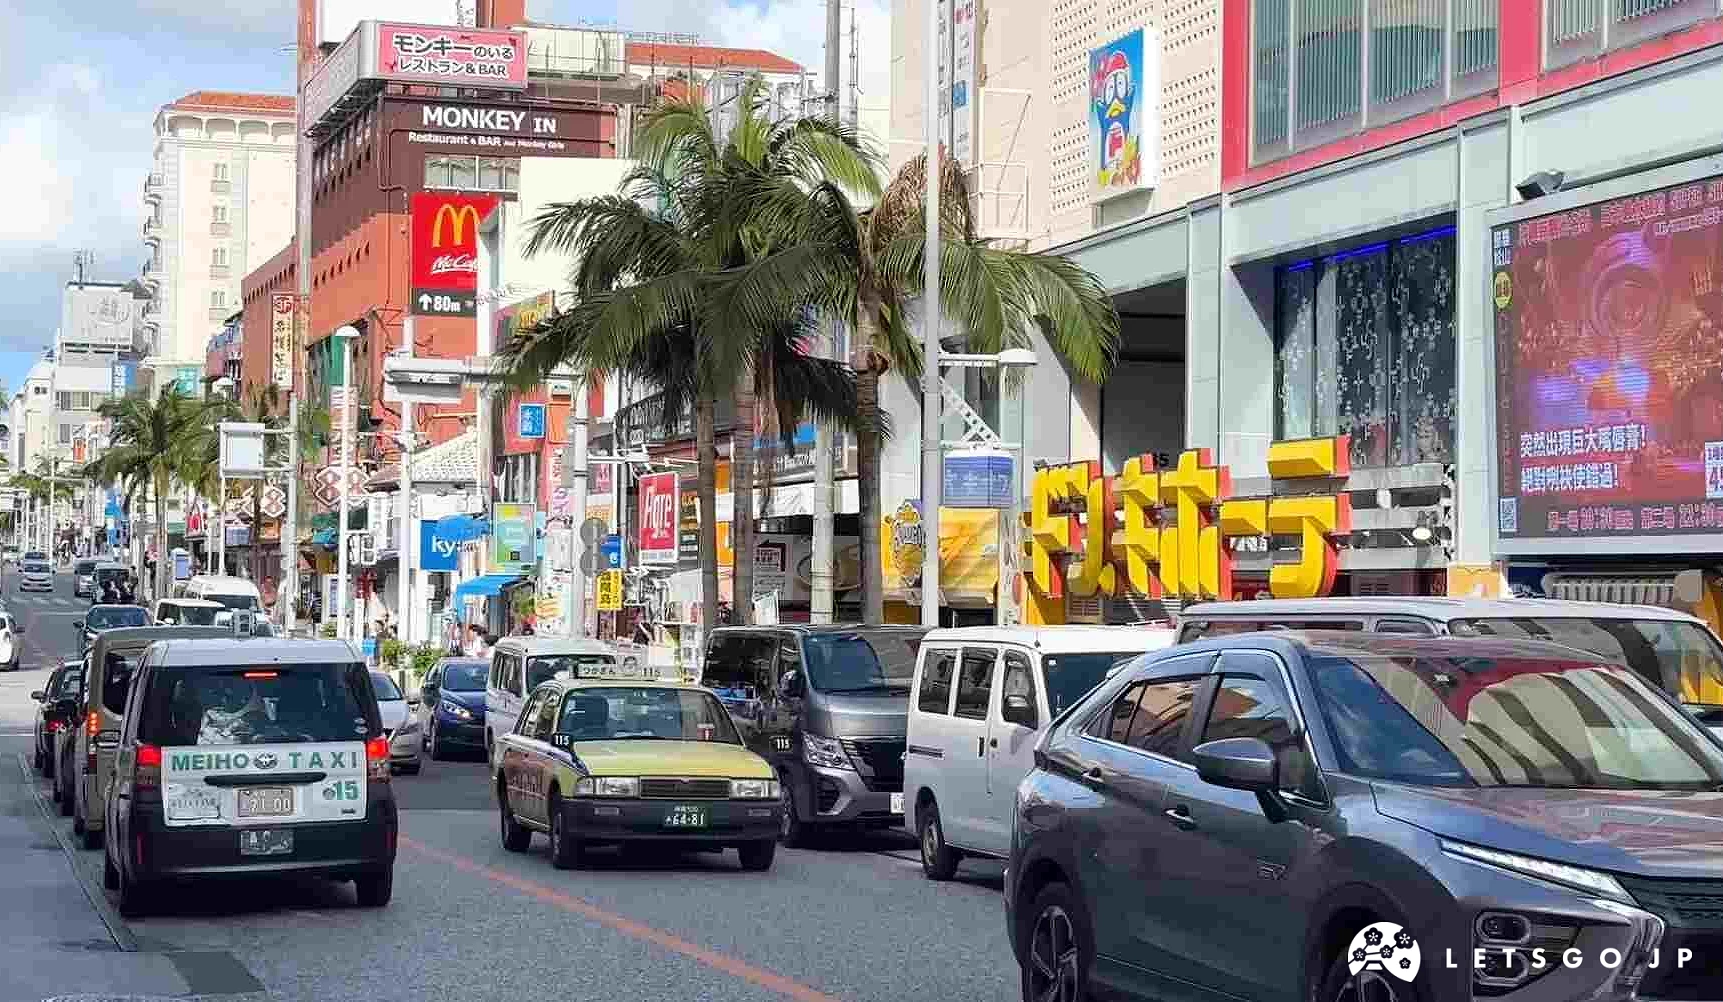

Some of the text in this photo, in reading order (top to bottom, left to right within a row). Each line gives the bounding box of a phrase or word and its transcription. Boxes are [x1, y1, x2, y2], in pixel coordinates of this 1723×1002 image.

[394, 34, 514, 59] モンキーのいる
[423, 105, 557, 133] MONKEY IN
[408, 132, 468, 146] Restaurant
[478, 137, 503, 148] BAR
[433, 295, 462, 313] 80m
[171, 750, 357, 771] MEIHO TAXI
